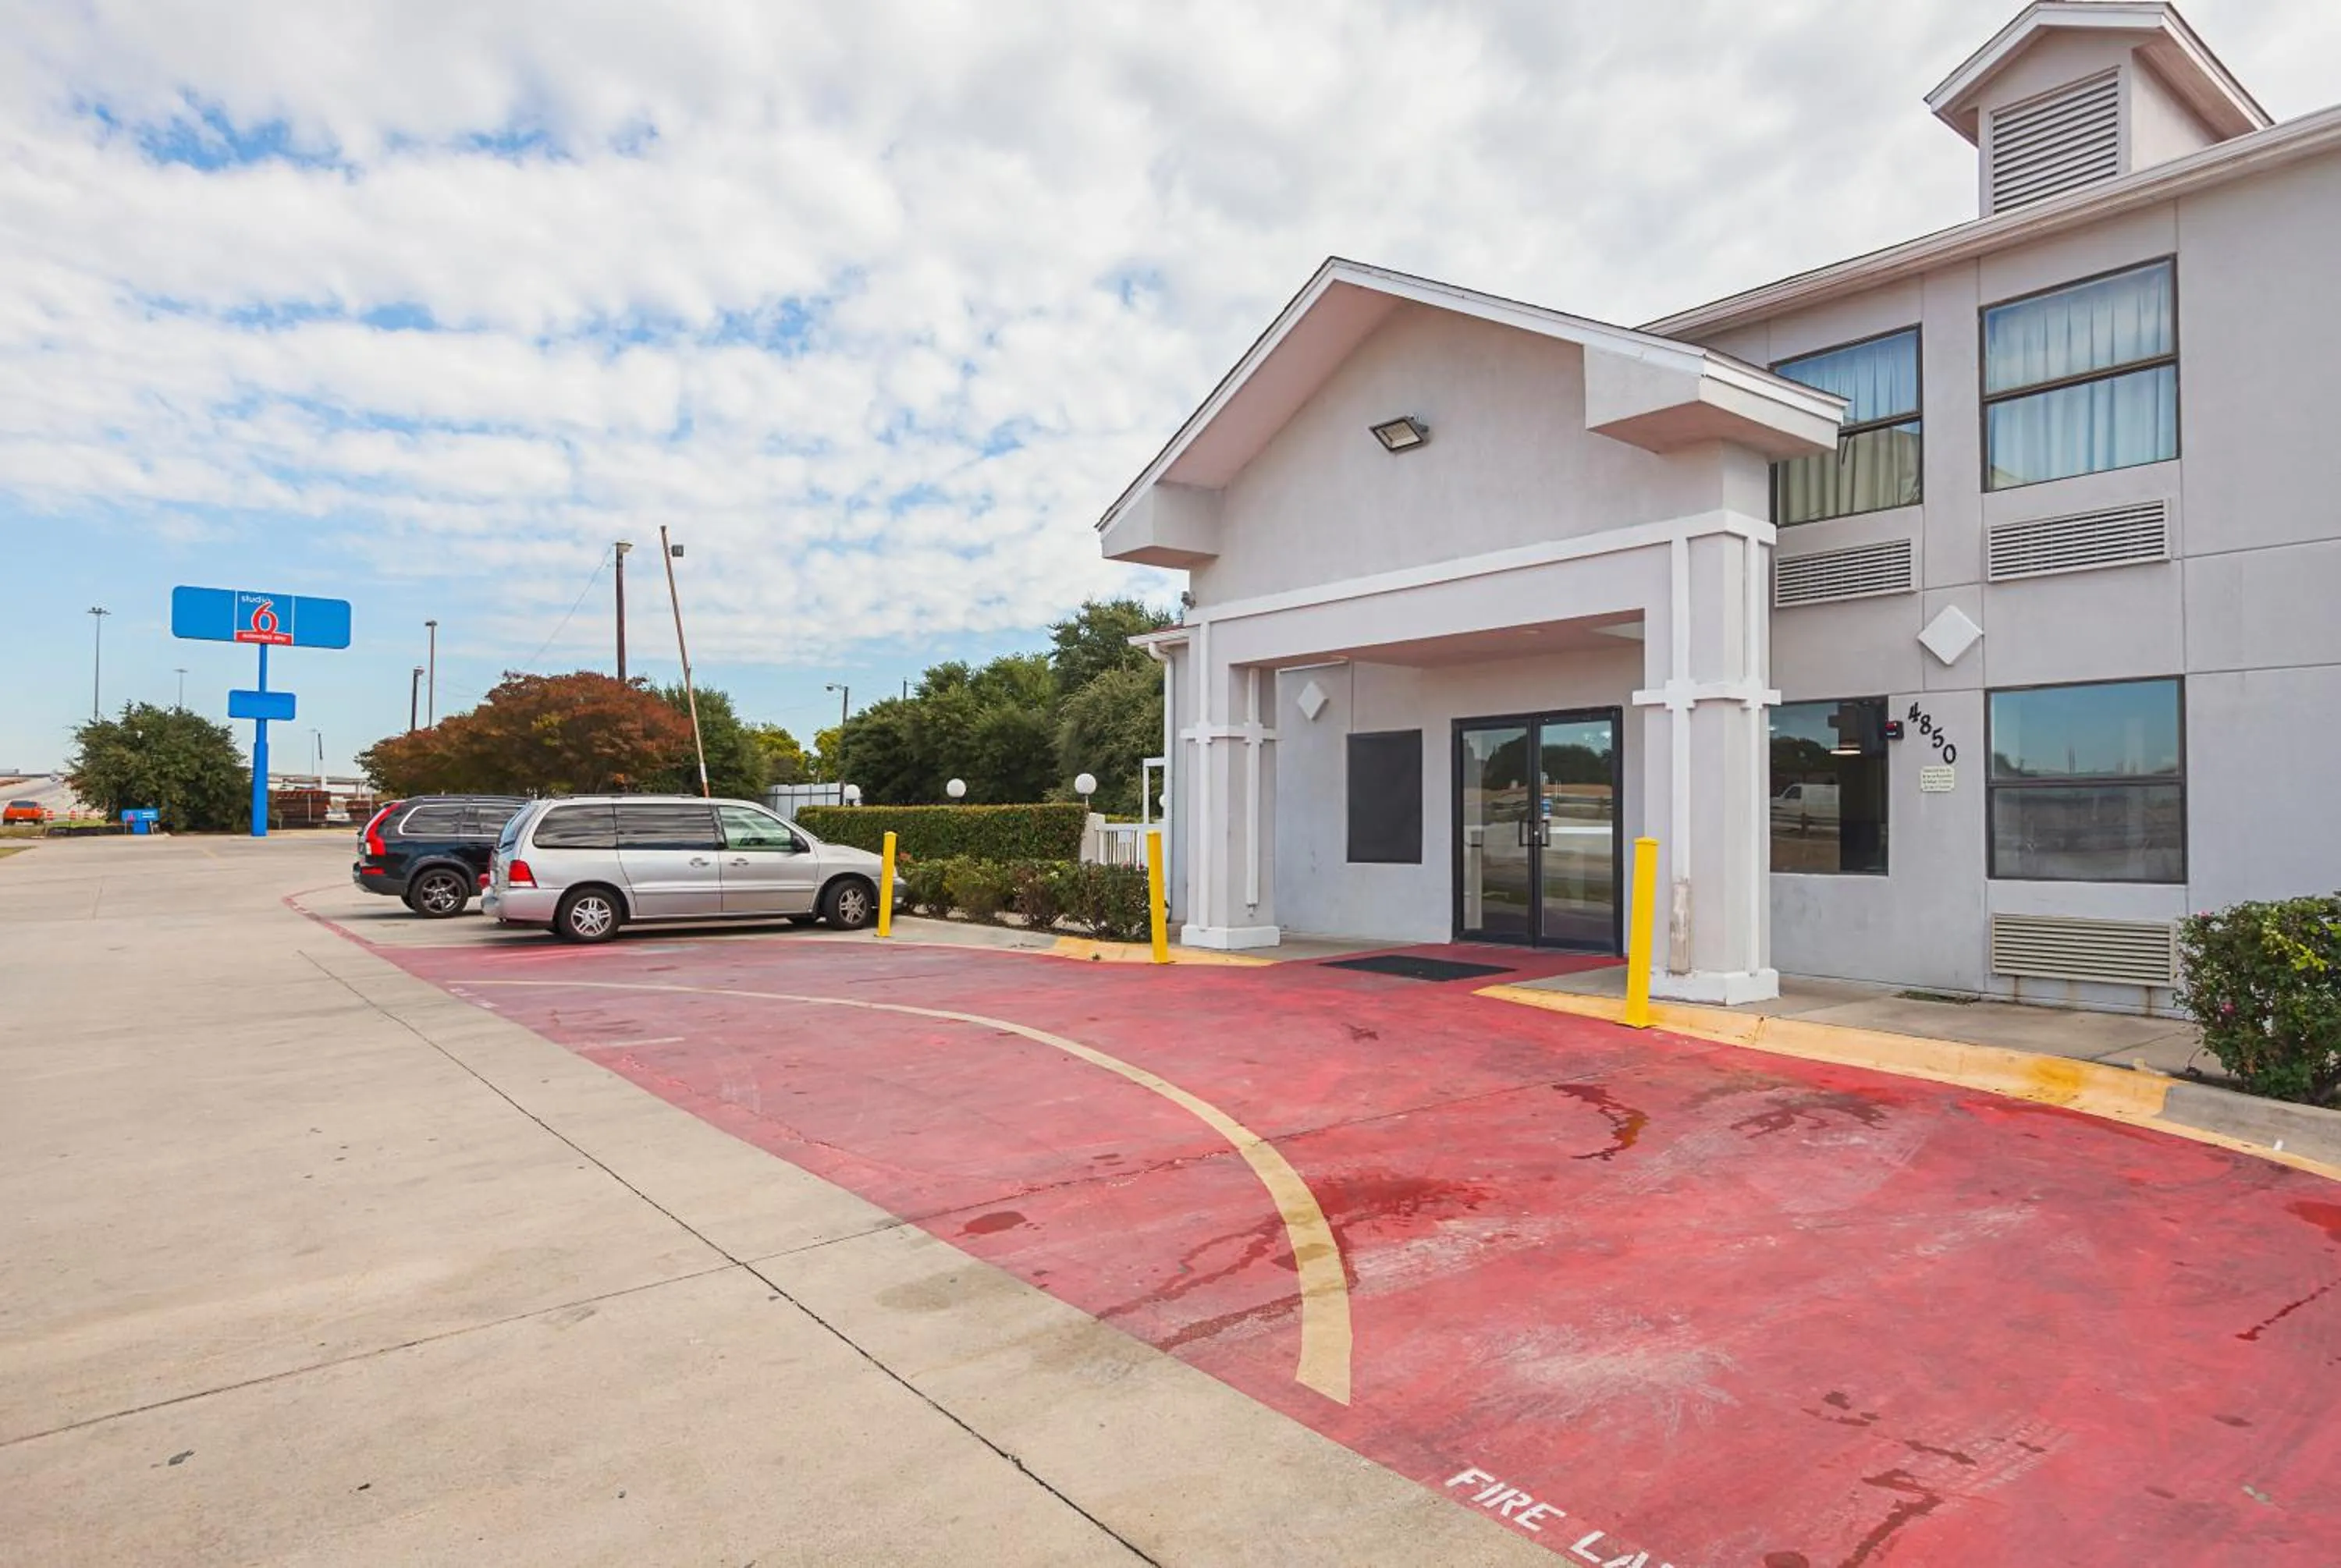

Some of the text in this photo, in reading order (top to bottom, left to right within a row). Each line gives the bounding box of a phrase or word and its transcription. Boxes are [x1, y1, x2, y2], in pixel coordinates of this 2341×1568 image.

[251, 601, 278, 633] 6
[1908, 702, 1956, 764] 4850
[1445, 1467, 1675, 1568] FIRE LA
